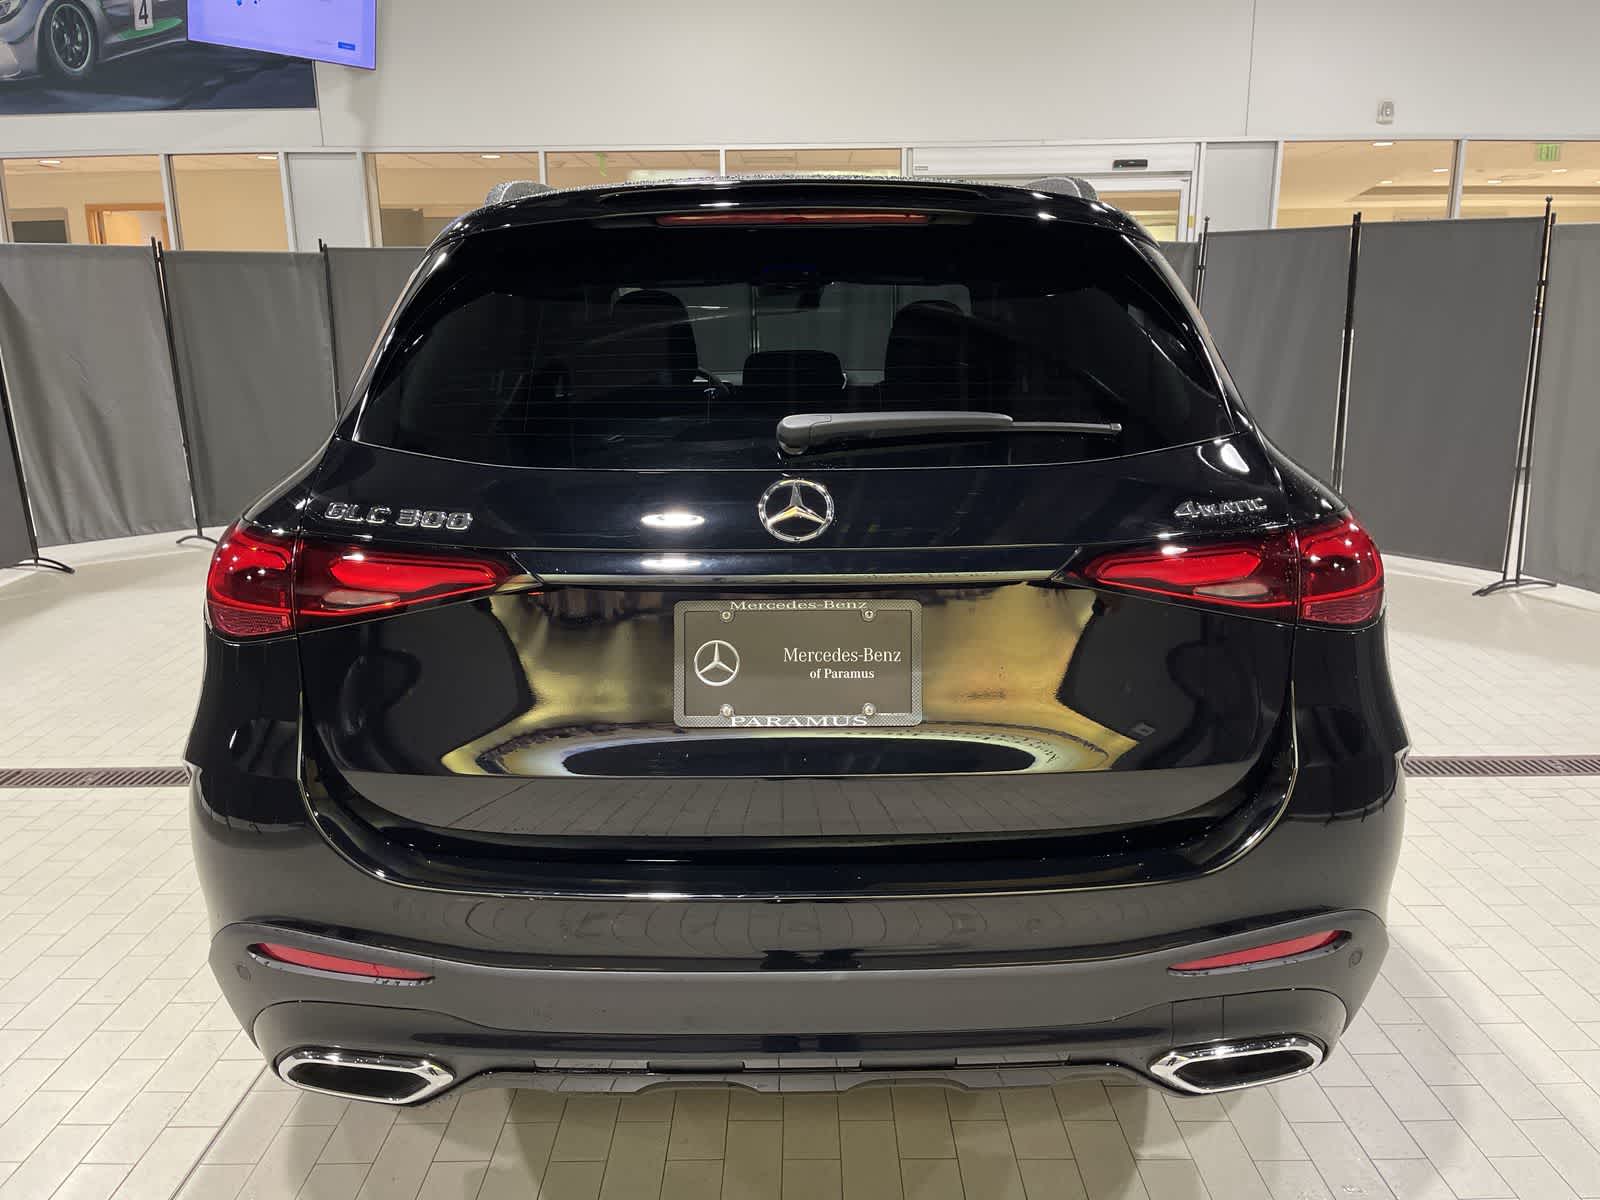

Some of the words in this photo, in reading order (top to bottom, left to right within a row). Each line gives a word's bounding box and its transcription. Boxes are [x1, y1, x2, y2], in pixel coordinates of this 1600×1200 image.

[138, 0, 149, 25] 4
[324, 502, 392, 524] GLC
[395, 508, 474, 531] 300
[729, 599, 868, 610] Mercedes-Benz
[783, 647, 902, 663] Mercedes-Benz
[809, 668, 821, 679] of
[824, 668, 875, 679] Paramus
[730, 715, 869, 727] PARAMUS
